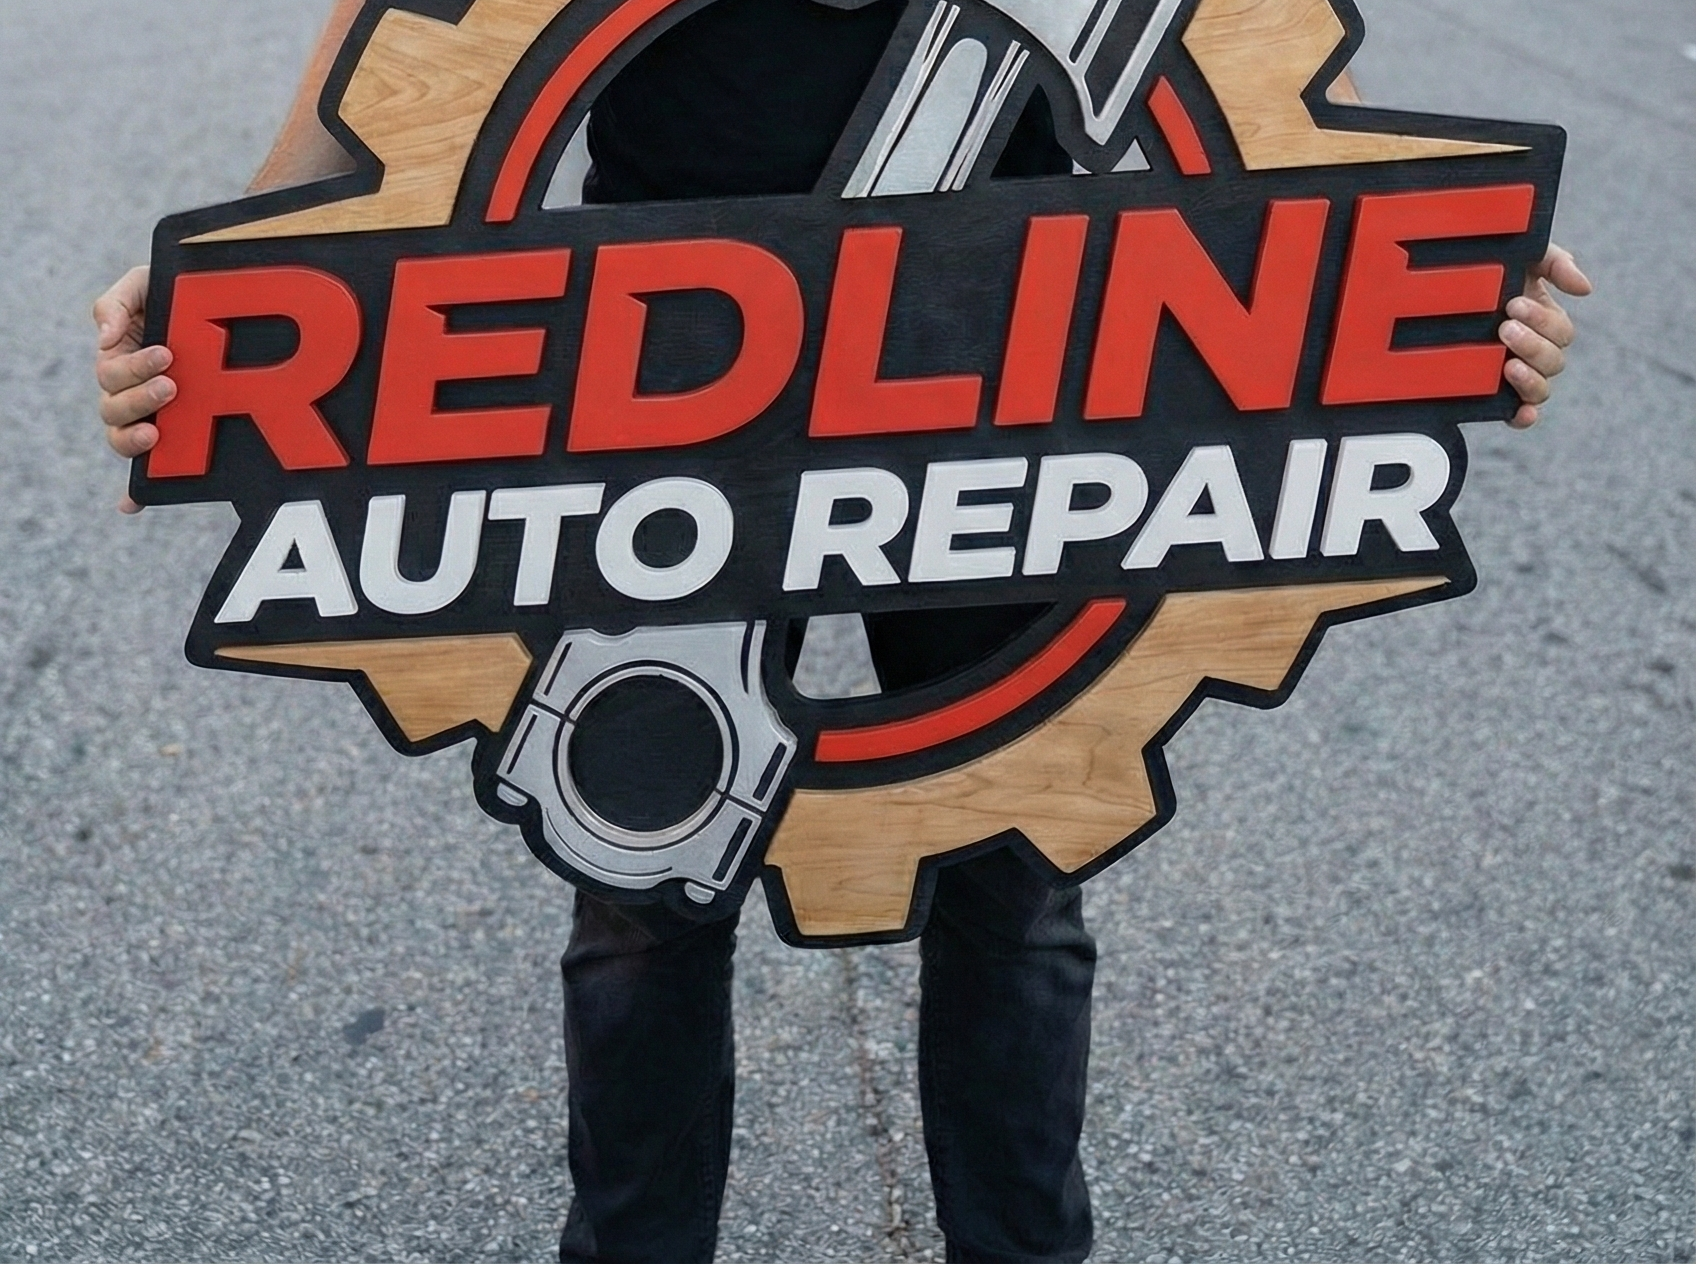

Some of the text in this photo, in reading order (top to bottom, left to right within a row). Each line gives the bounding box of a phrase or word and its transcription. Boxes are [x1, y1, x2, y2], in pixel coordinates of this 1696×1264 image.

[147, 182, 1535, 478] REDLINE
[214, 432, 1451, 624] AUTO REPAIR
